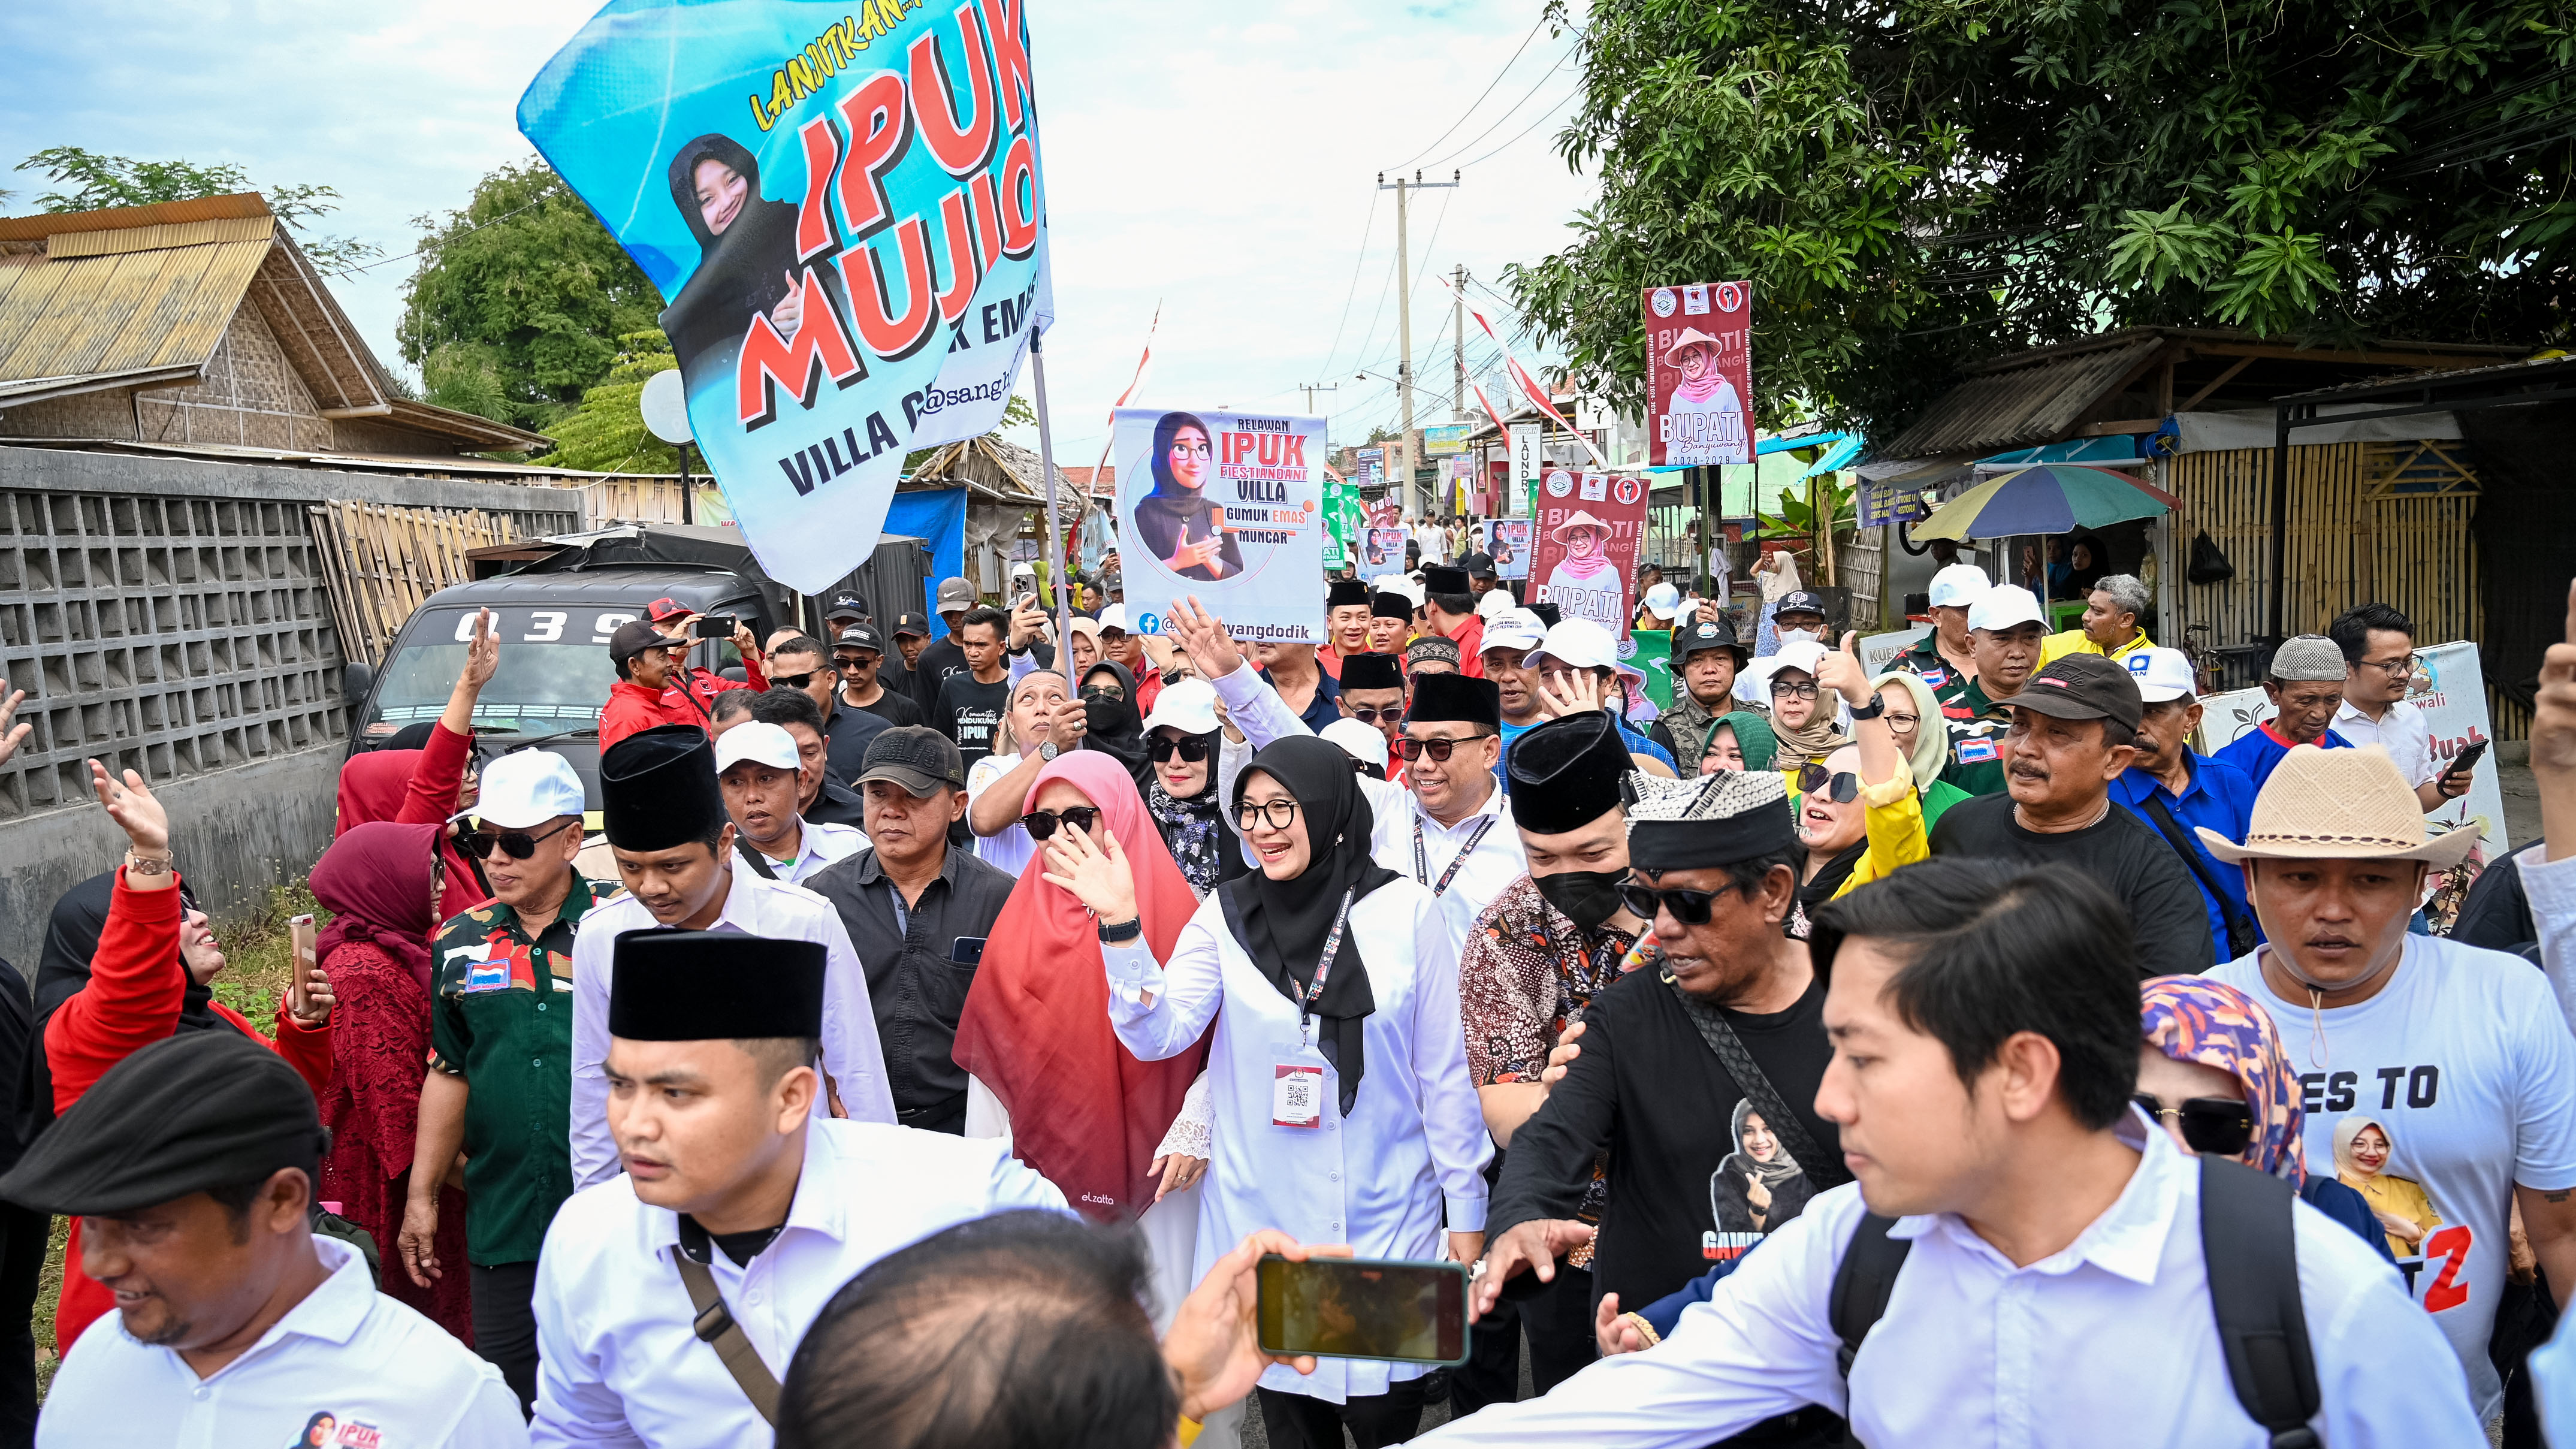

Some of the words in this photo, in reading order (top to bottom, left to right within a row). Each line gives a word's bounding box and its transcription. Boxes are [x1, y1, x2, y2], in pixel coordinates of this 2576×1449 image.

[798, 0, 1030, 262] IPUK
[1238, 419, 1289, 433] RELAWAN
[1659, 411, 1745, 442] BUPATI
[1221, 431, 1308, 469] IPUK
[1681, 437, 1746, 455] Banyuwangi
[779, 414, 899, 497] VILLA
[1674, 456, 1730, 465] 2024-2029
[1220, 466, 1308, 482] FIESTIANDANI
[1237, 480, 1288, 504] VILLA
[1227, 507, 1269, 522] GUMUK
[1273, 510, 1305, 524] EMAS
[1898, 504, 1916, 514] RESTORA
[1239, 530, 1288, 544] MUNCAR
[1508, 525, 1528, 533] IPUK
[524, 611, 568, 642] 3
[1868, 647, 1894, 665] KUE
[956, 707, 996, 719] Komunitas
[963, 726, 989, 739] IPUK
[2376, 1064, 2439, 1110] TO
[2424, 1225, 2474, 1314] 2
[338, 1423, 382, 1445] IPUK
